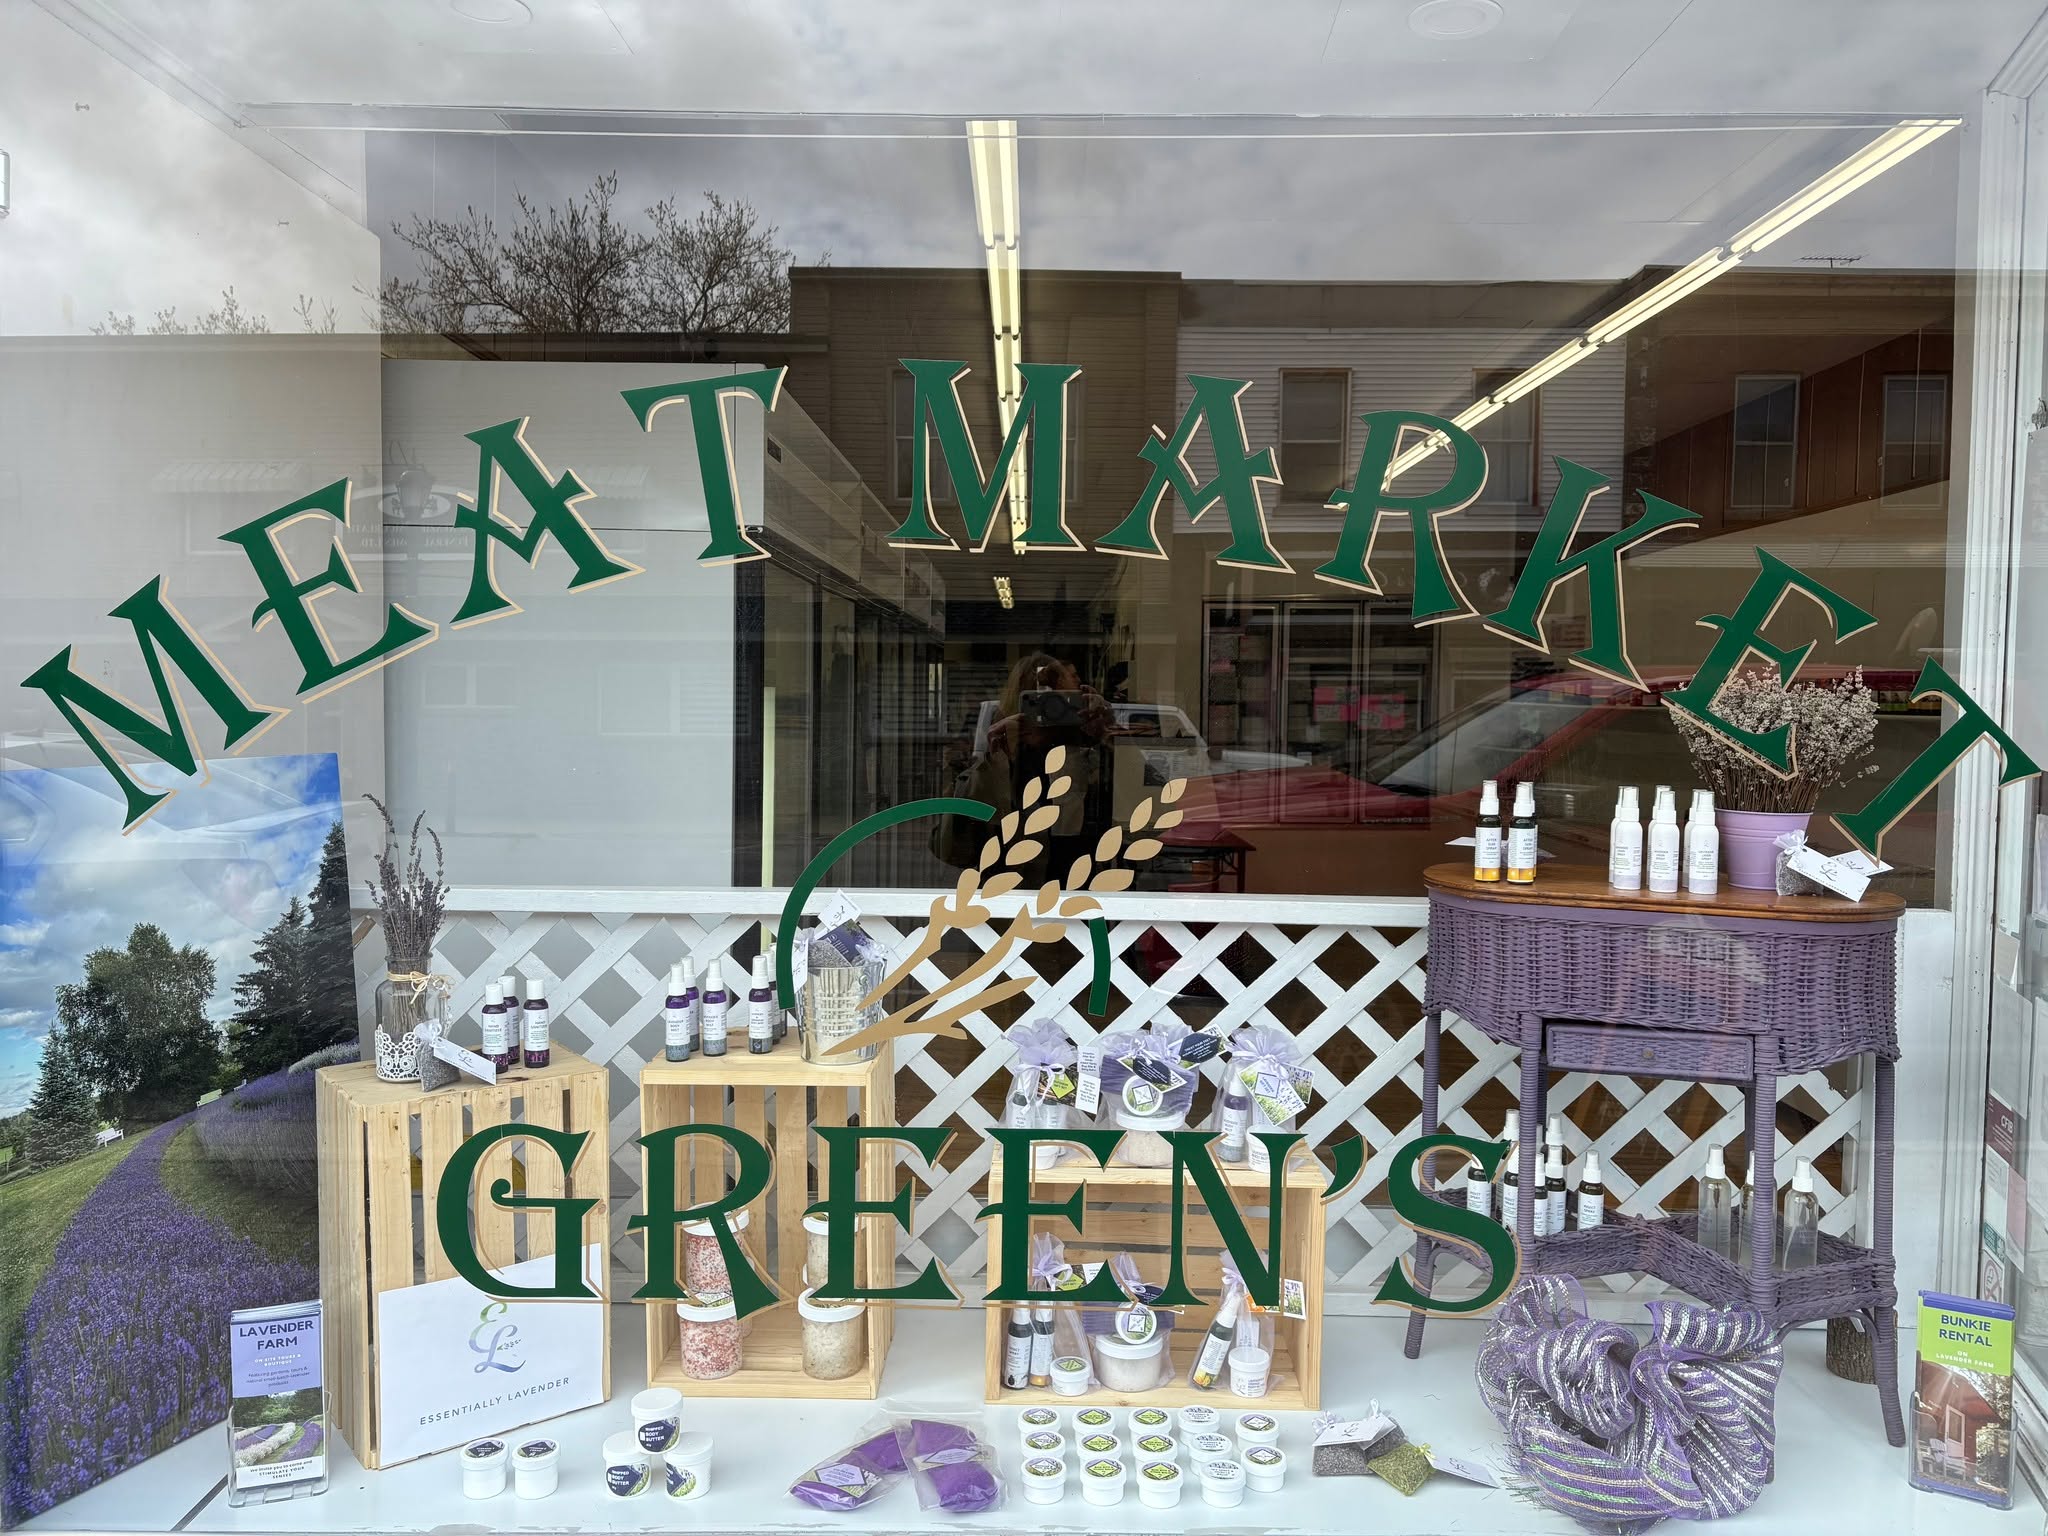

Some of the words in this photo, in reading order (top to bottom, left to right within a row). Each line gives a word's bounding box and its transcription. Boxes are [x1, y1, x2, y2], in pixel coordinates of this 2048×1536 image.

[20, 365, 788, 836] MEAT
[886, 358, 2042, 866] MARKET
[434, 1122, 1524, 1319] GREEN'S
[239, 1320, 315, 1338] LAVENDER
[1941, 1314, 1992, 1332] BUNKIE
[257, 1336, 299, 1351] FARM
[1939, 1328, 1993, 1347] RENTAL
[1936, 1353, 1972, 1364] LAVENDER
[1974, 1360, 1994, 1368] FARM
[420, 1396, 502, 1426] ESSENTIALLY
[508, 1377, 570, 1401] LAVENDER
